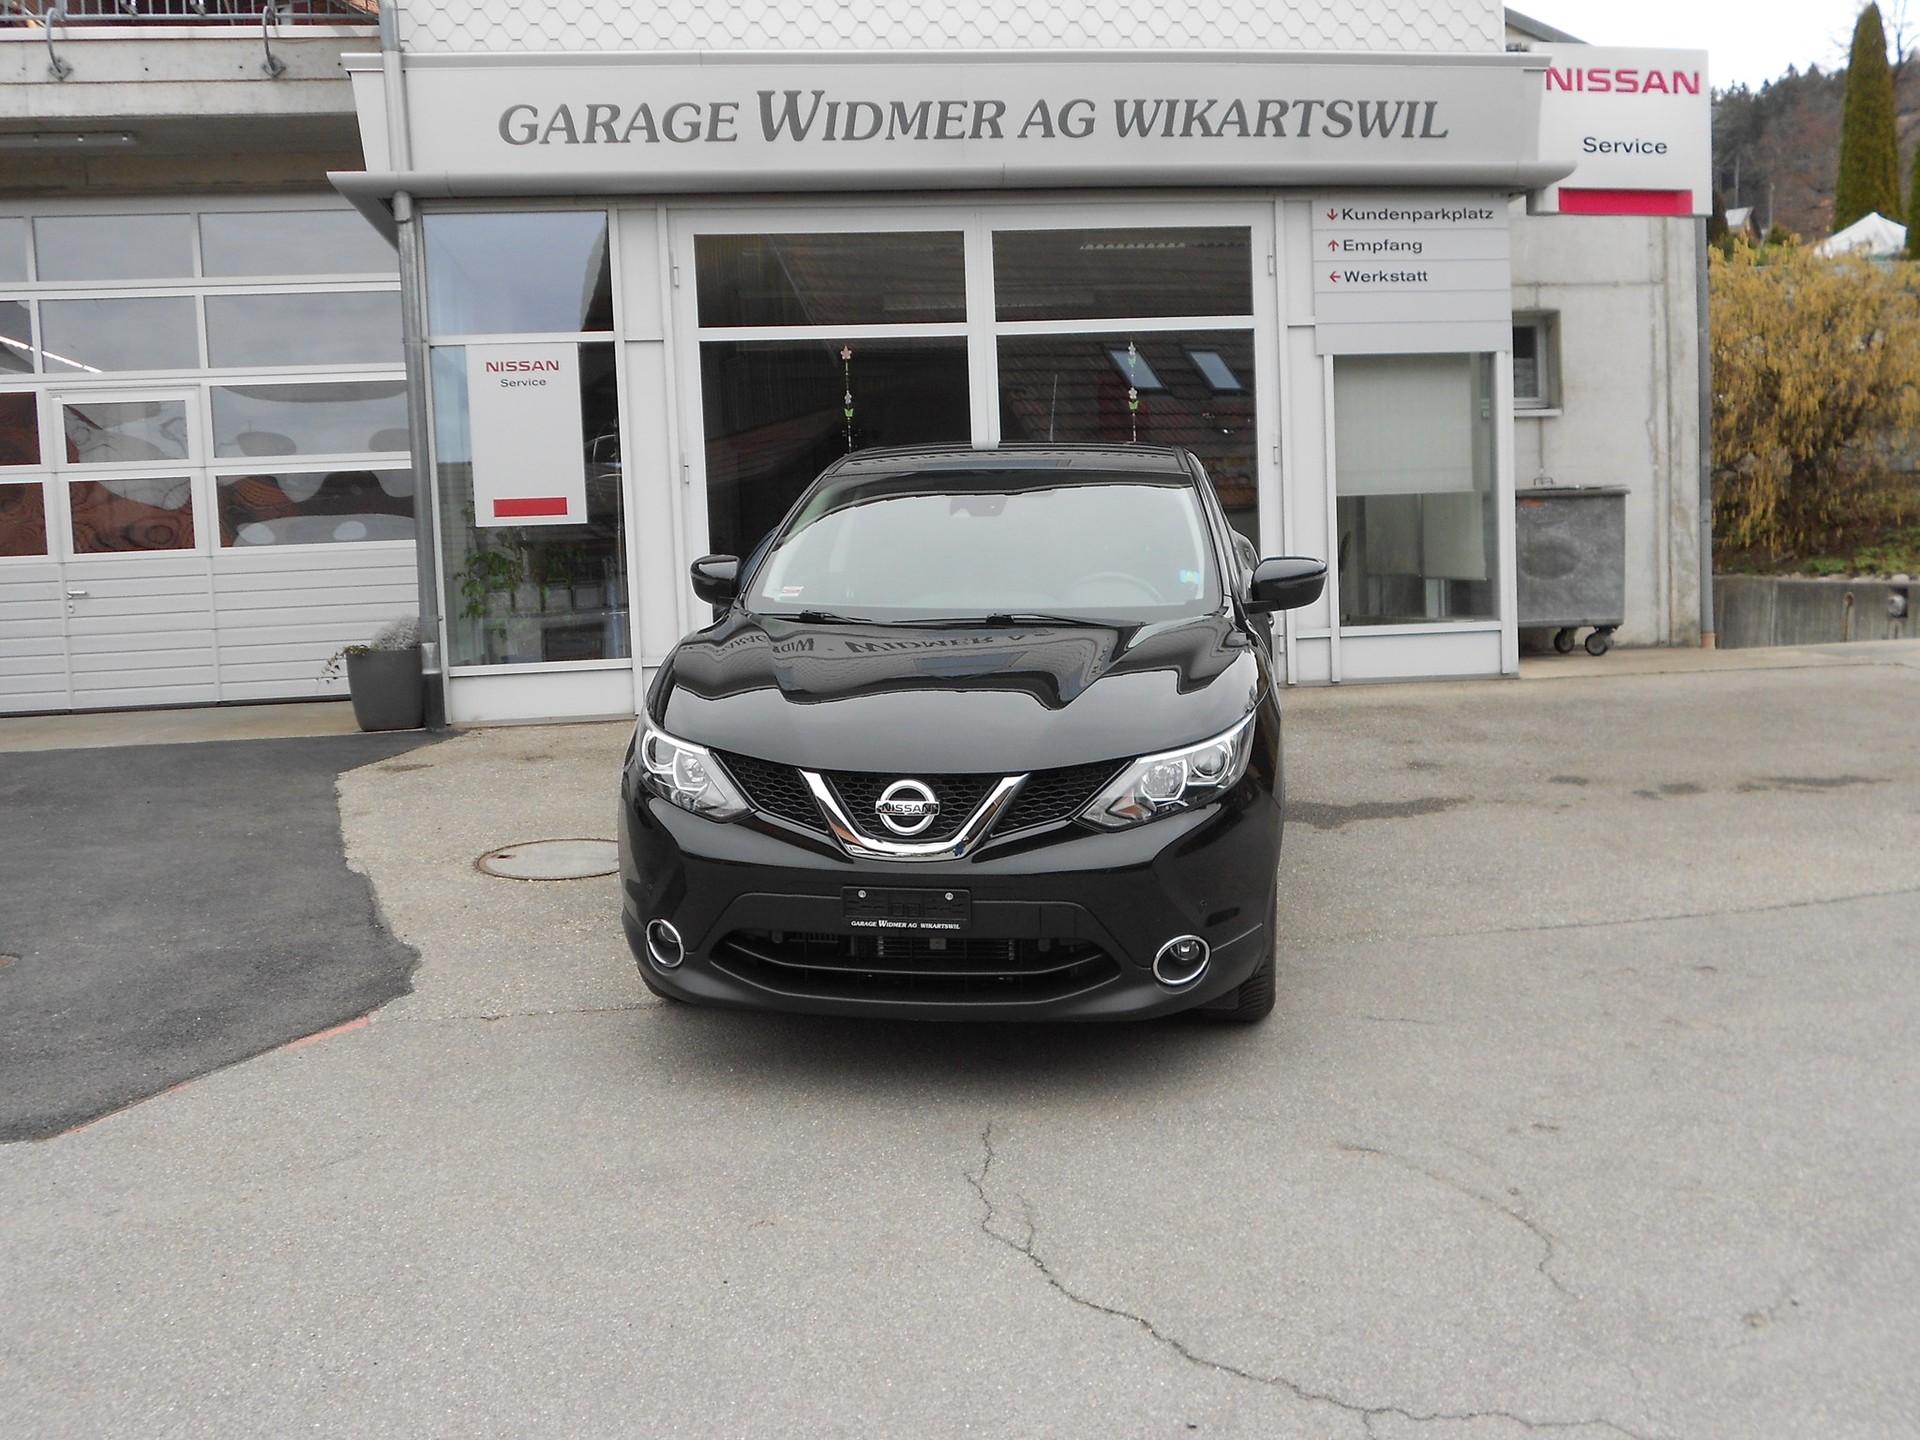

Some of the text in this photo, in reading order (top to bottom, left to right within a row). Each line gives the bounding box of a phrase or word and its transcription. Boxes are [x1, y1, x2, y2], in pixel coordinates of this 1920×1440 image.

[1545, 66, 1700, 95] NISSAN
[498, 89, 1449, 146] GARAGE WIDMER AG WIKARTSWIL
[1583, 136, 1668, 155] Service
[1341, 207, 1494, 223] Kundenparkplatz
[1343, 239, 1423, 254] Empfang
[1344, 270, 1428, 283] Werkstatt
[486, 359, 560, 373] NISSAN
[500, 378, 547, 388] Service
[881, 802, 932, 814] NISSAN
[878, 920, 907, 928] WIDMER
[920, 922, 961, 930] WIKARTSWIL
